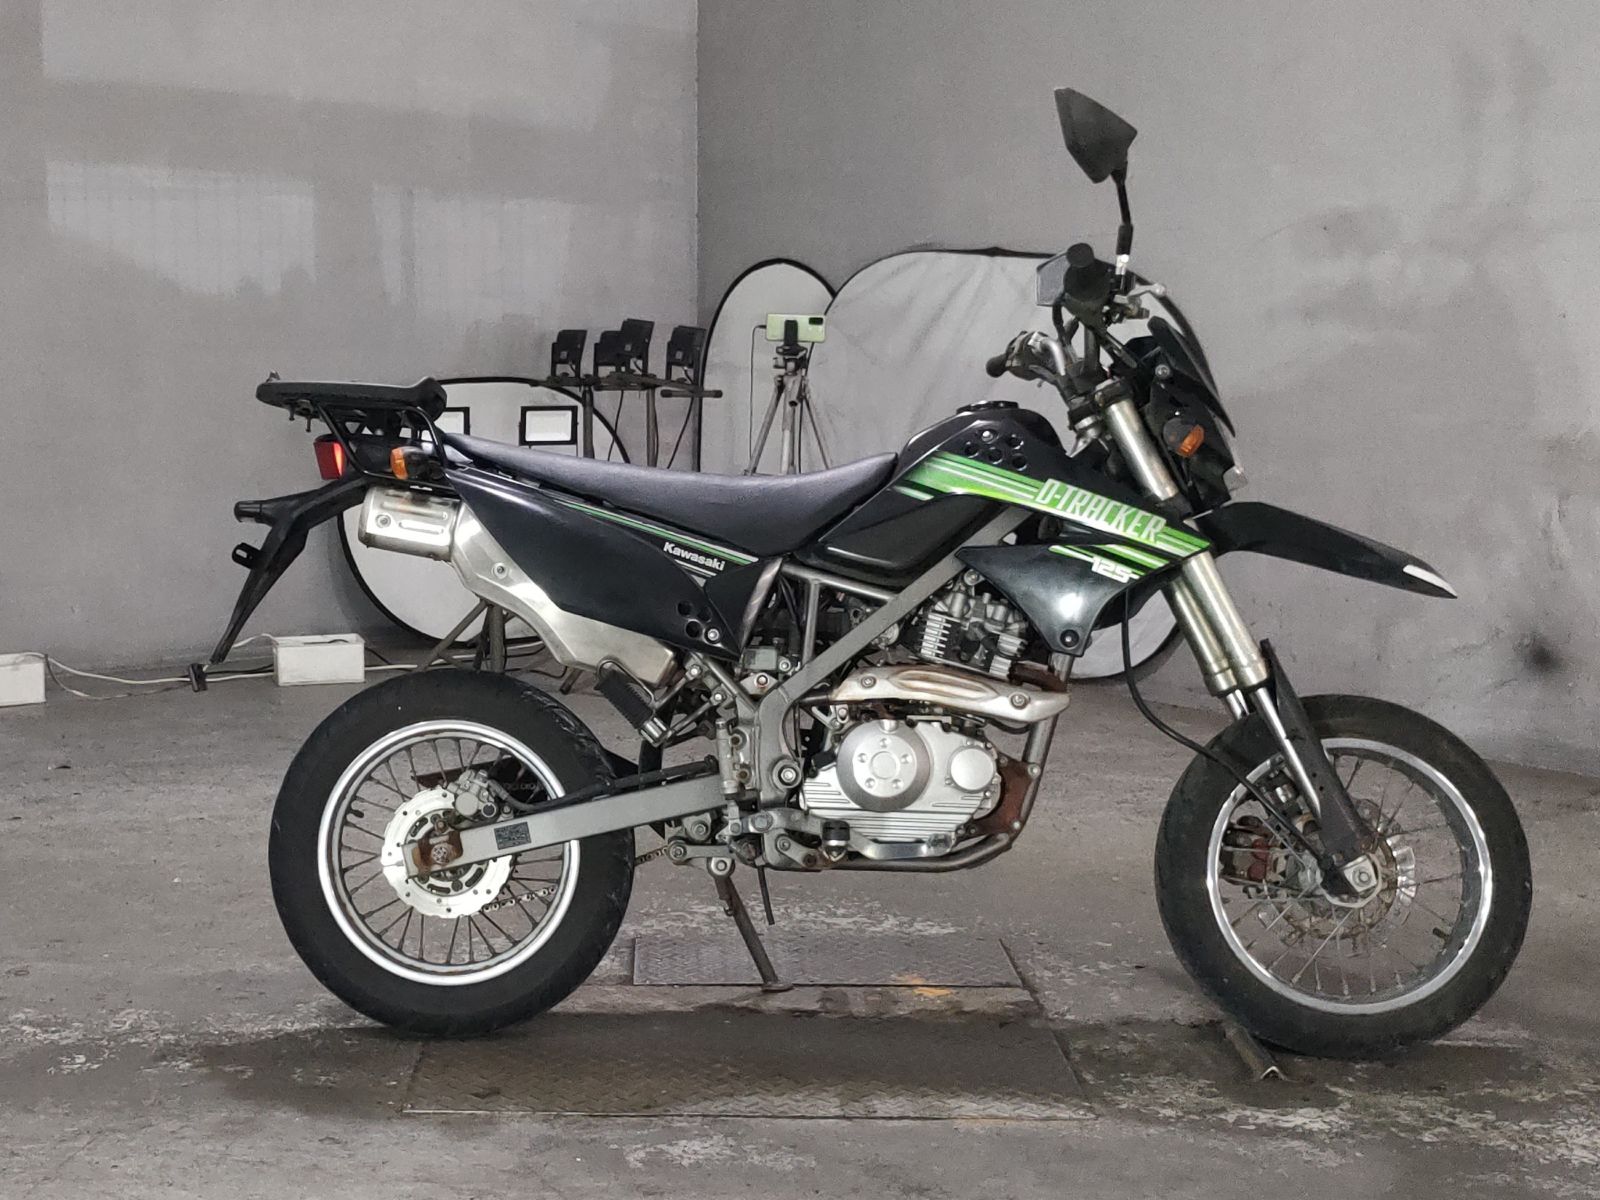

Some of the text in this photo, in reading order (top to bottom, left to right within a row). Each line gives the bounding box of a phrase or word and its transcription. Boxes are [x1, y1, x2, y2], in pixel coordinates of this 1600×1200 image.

[1035, 478, 1167, 544] D-TRACKER
[663, 541, 725, 571] Kawasaki
[1091, 556, 1132, 583] 125
